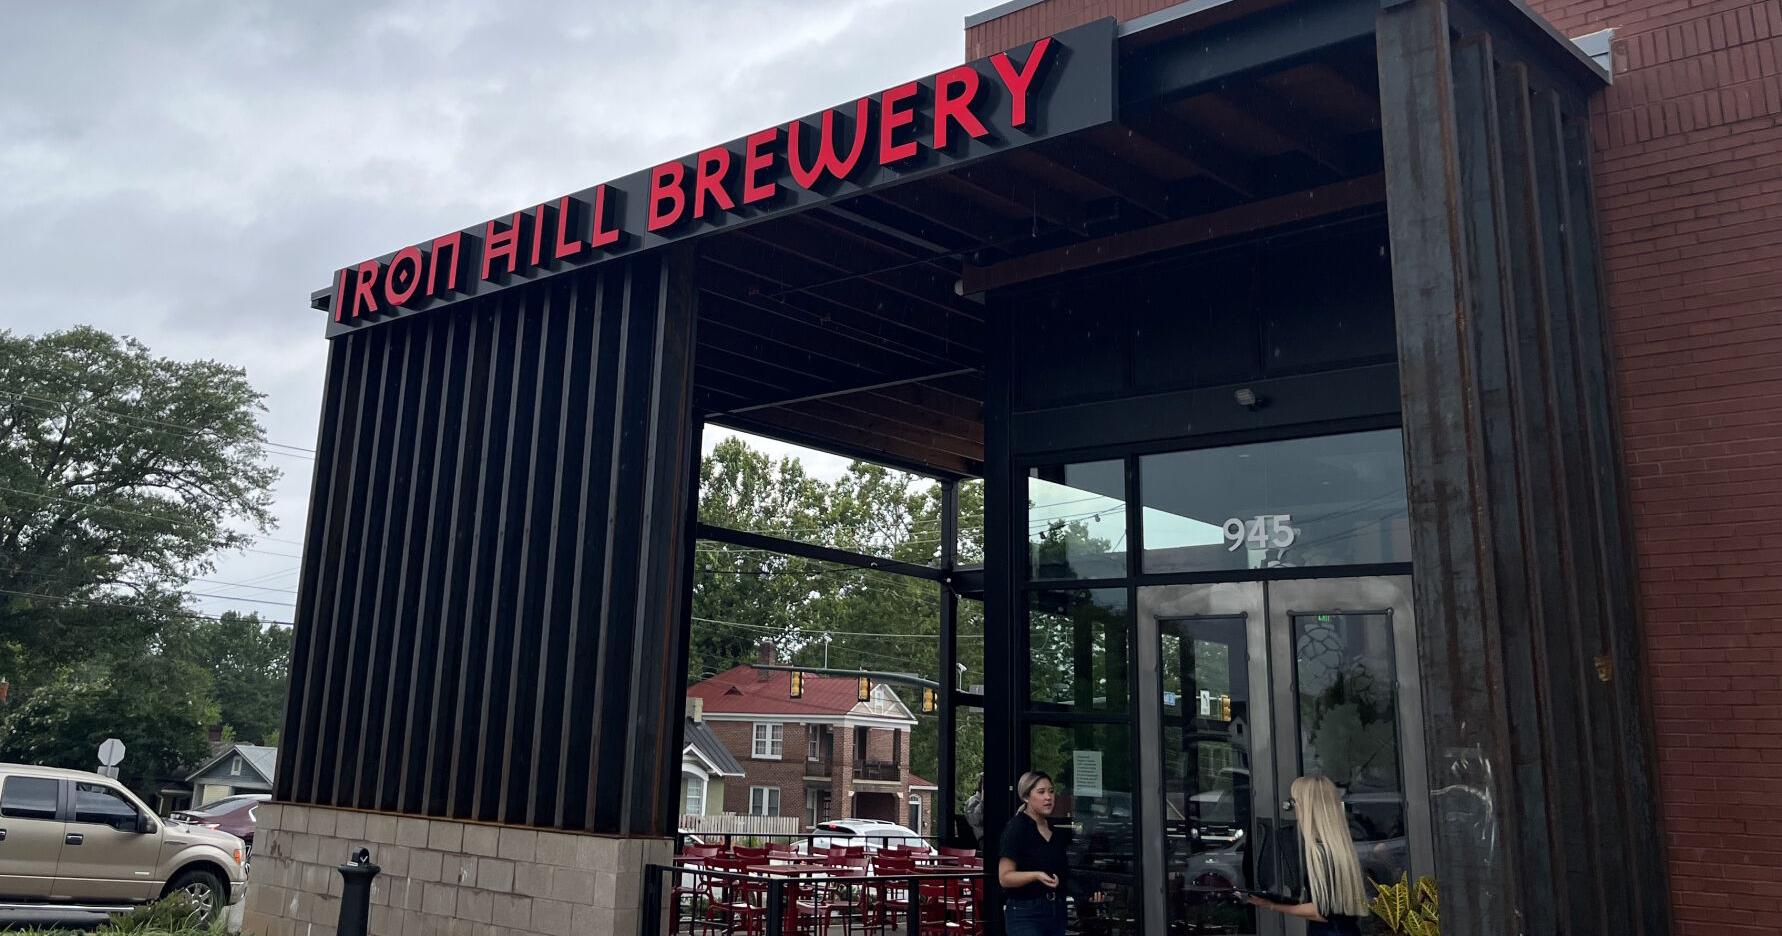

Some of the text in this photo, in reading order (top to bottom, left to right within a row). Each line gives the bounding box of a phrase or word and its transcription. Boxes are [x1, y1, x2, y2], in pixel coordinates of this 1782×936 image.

[334, 37, 1052, 323] IRON HILL BREWERY
[1222, 514, 1295, 552] 945
